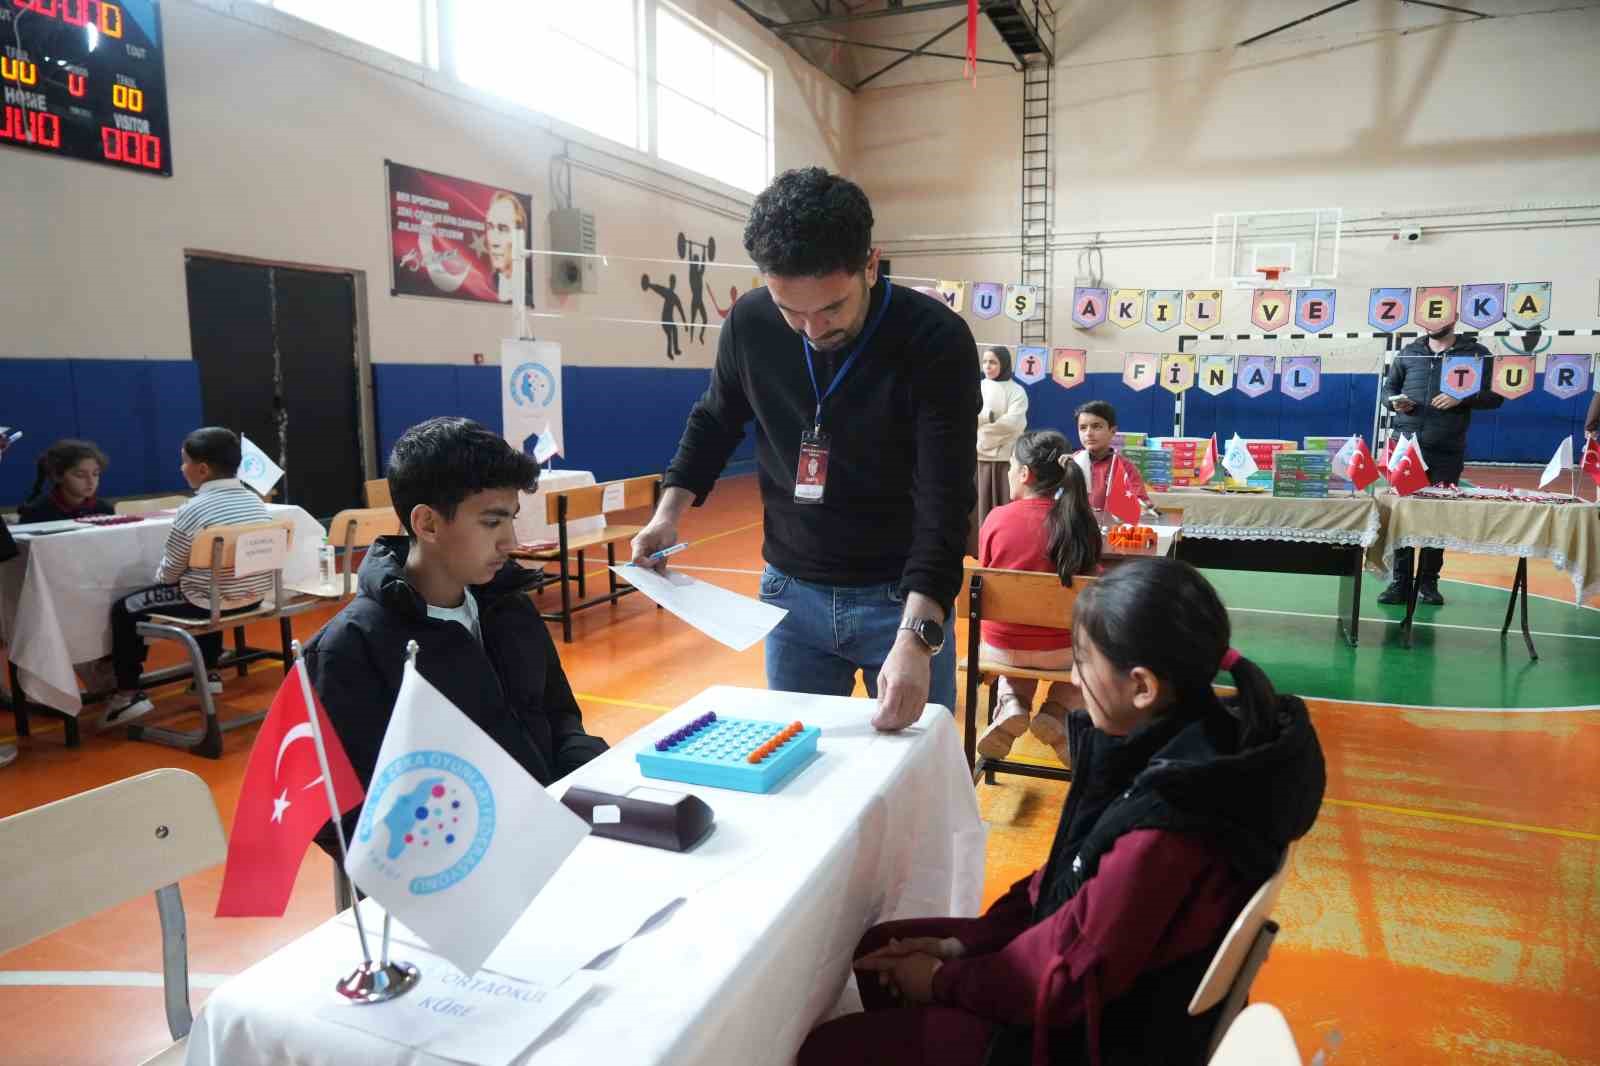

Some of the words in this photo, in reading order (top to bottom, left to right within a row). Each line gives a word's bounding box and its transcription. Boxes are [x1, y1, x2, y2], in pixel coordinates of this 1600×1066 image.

[4, 85, 47, 111] HOME
[112, 84, 144, 112] 00
[113, 113, 150, 134] VISITOR
[101, 126, 161, 169] 000
[1081, 300, 1210, 321] AKIL
[1261, 300, 1323, 321] VE
[1380, 295, 1539, 320] ZEKA
[1025, 355, 1075, 378] İL
[1132, 362, 1307, 388] FİNAL
